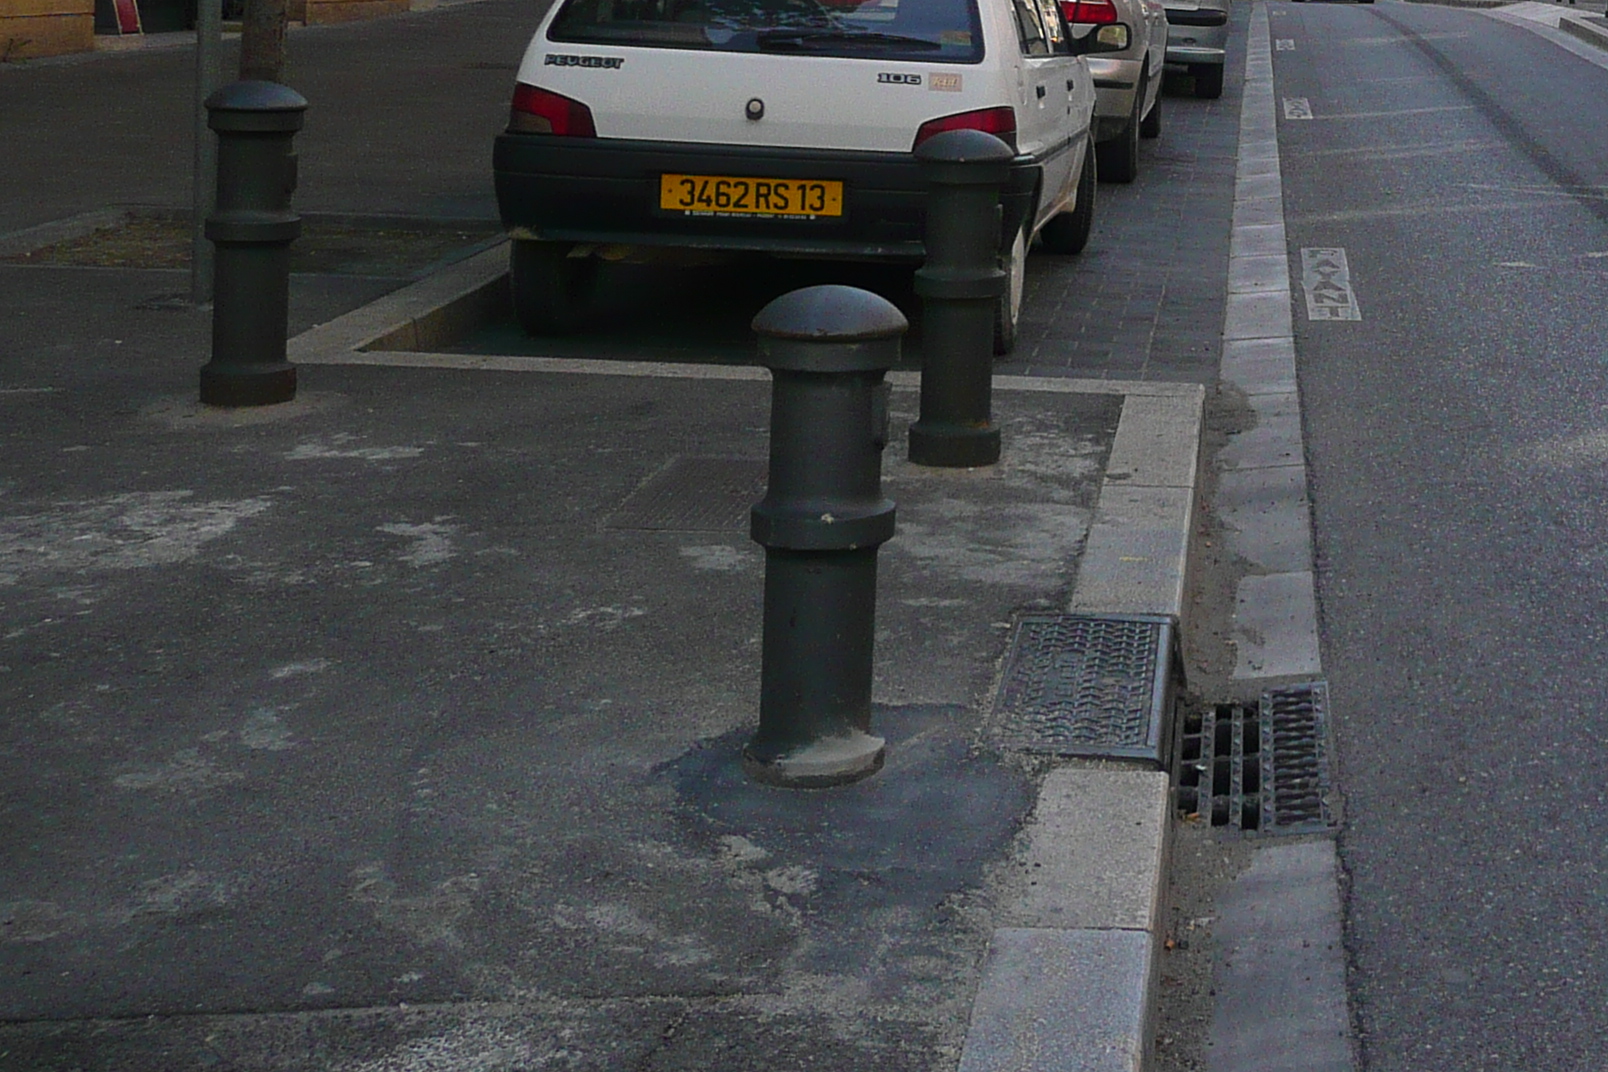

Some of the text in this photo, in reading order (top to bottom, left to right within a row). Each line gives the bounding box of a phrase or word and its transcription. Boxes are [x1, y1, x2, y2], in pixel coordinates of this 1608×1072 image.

[544, 54, 625, 70] PEUGEOT
[877, 72, 922, 86] 106
[679, 179, 826, 212] 3462 RS 13
